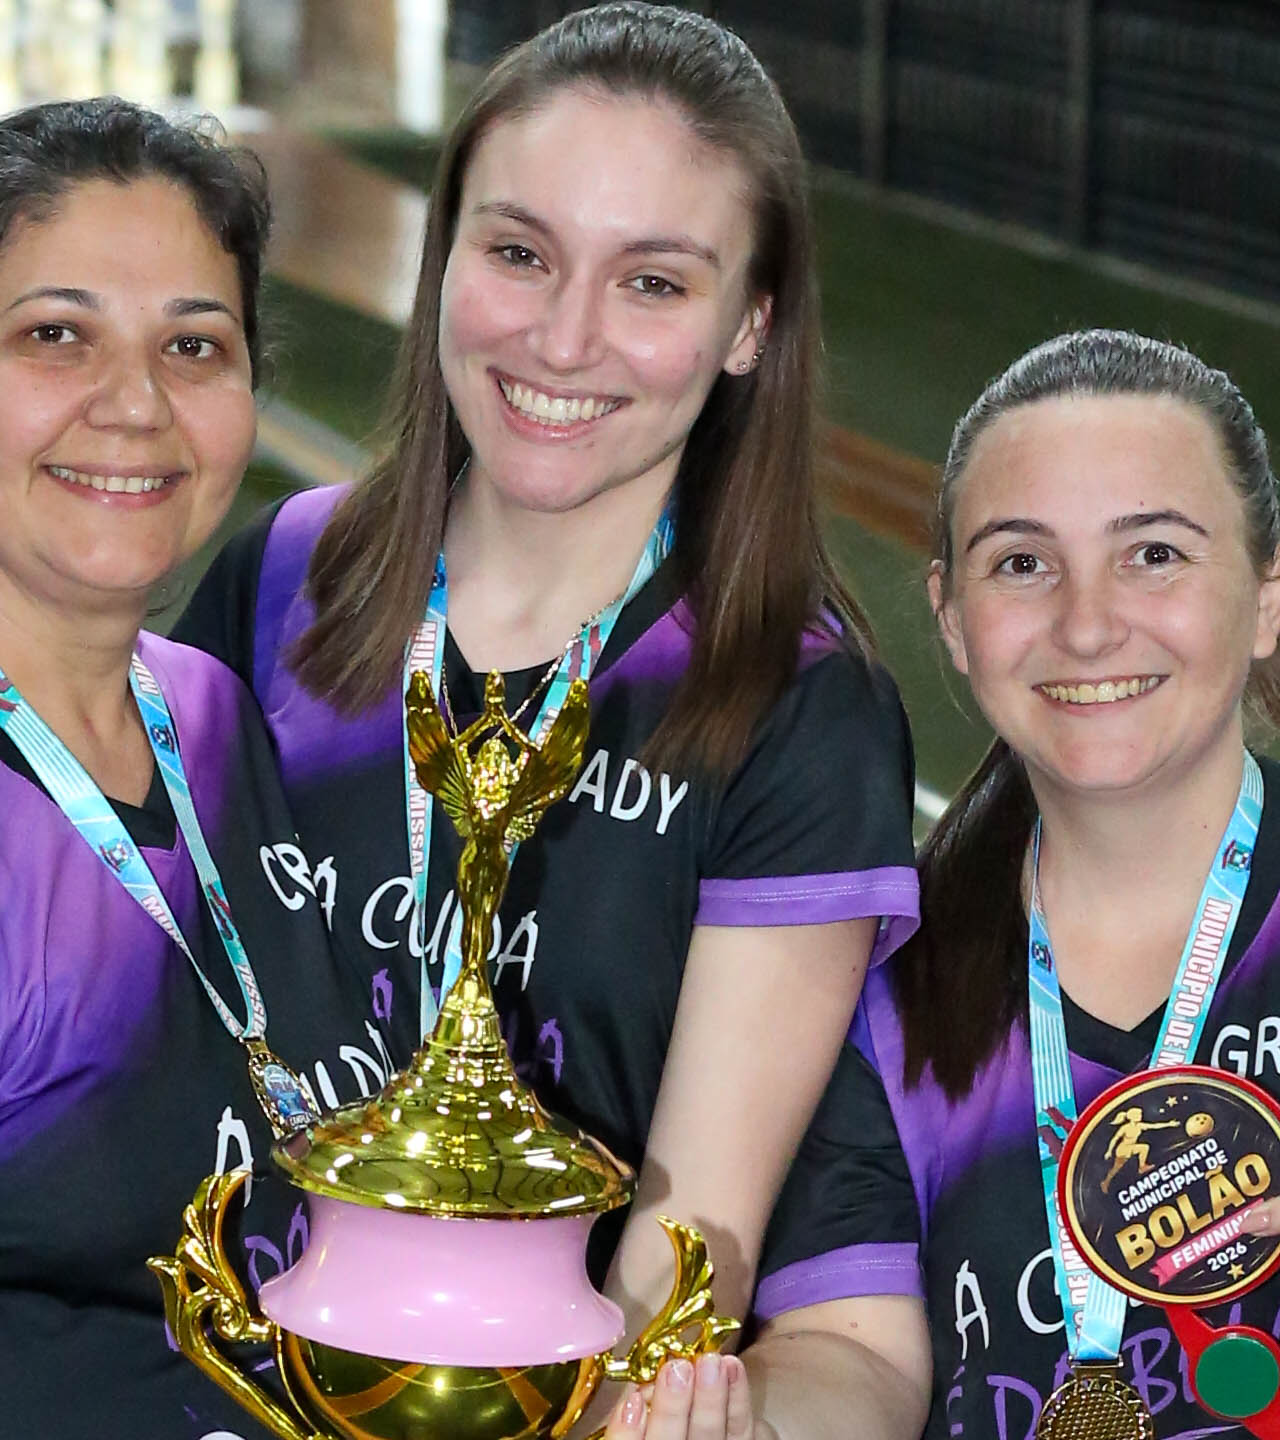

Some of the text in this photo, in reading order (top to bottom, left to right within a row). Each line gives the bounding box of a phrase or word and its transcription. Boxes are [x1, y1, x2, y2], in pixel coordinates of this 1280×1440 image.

[1173, 897, 1233, 1017] MUNICÍPIO
[1163, 1019, 1195, 1050] DE
[1118, 1137, 1218, 1206] CAMPEONATO
[1121, 1148, 1228, 1222] MUNICIPAL DE
[1114, 1153, 1272, 1270] BOLÃO
[1207, 1241, 1248, 1271] 2026
